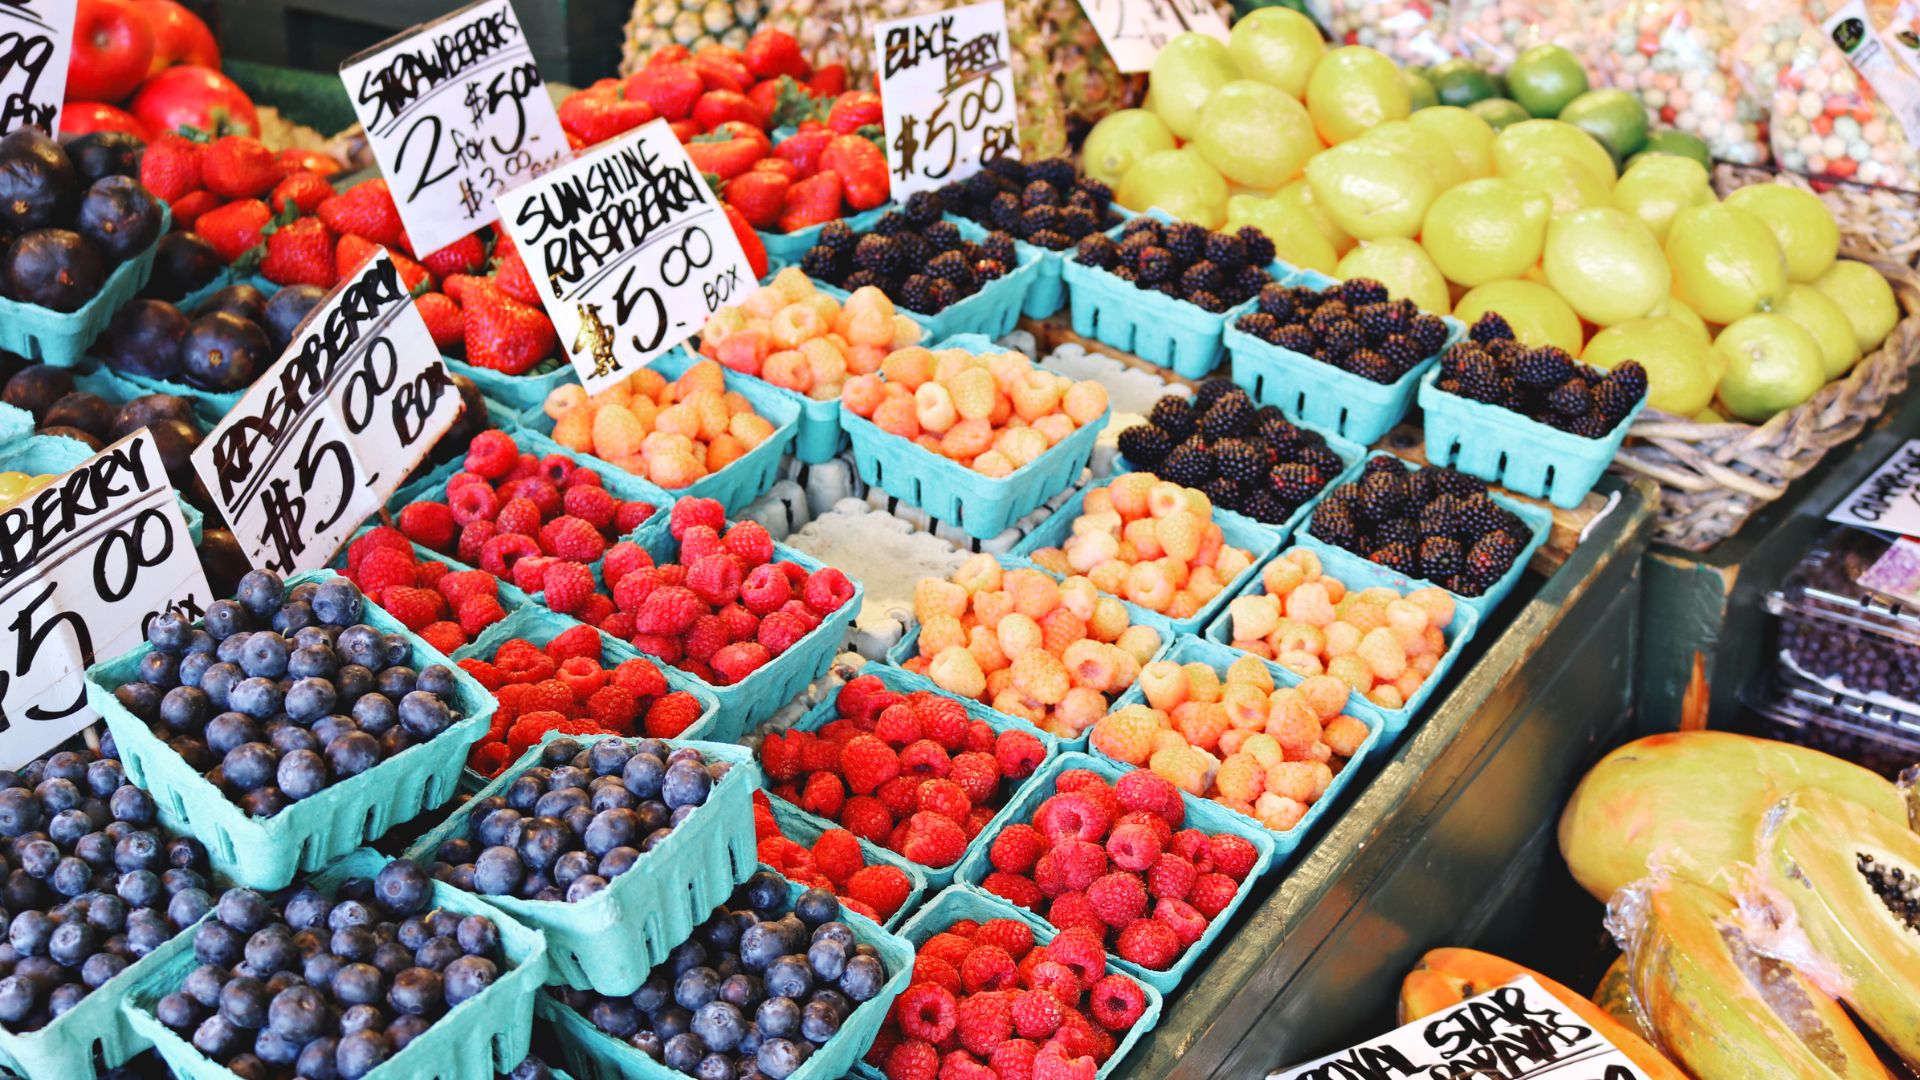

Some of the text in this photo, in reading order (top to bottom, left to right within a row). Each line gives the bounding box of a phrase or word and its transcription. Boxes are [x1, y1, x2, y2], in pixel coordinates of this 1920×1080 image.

[885, 16, 958, 80] BLACK
[945, 31, 1000, 87] BERRY
[394, 115, 460, 203] 2
[451, 129, 486, 168] for
[517, 139, 659, 245] SUNSHINE
[544, 161, 707, 298] RASPBERRY
[703, 265, 744, 312] BOX
[213, 257, 405, 506] RASPBERRY
[392, 361, 454, 448] BOX
[1424, 987, 1558, 1060] STAR
